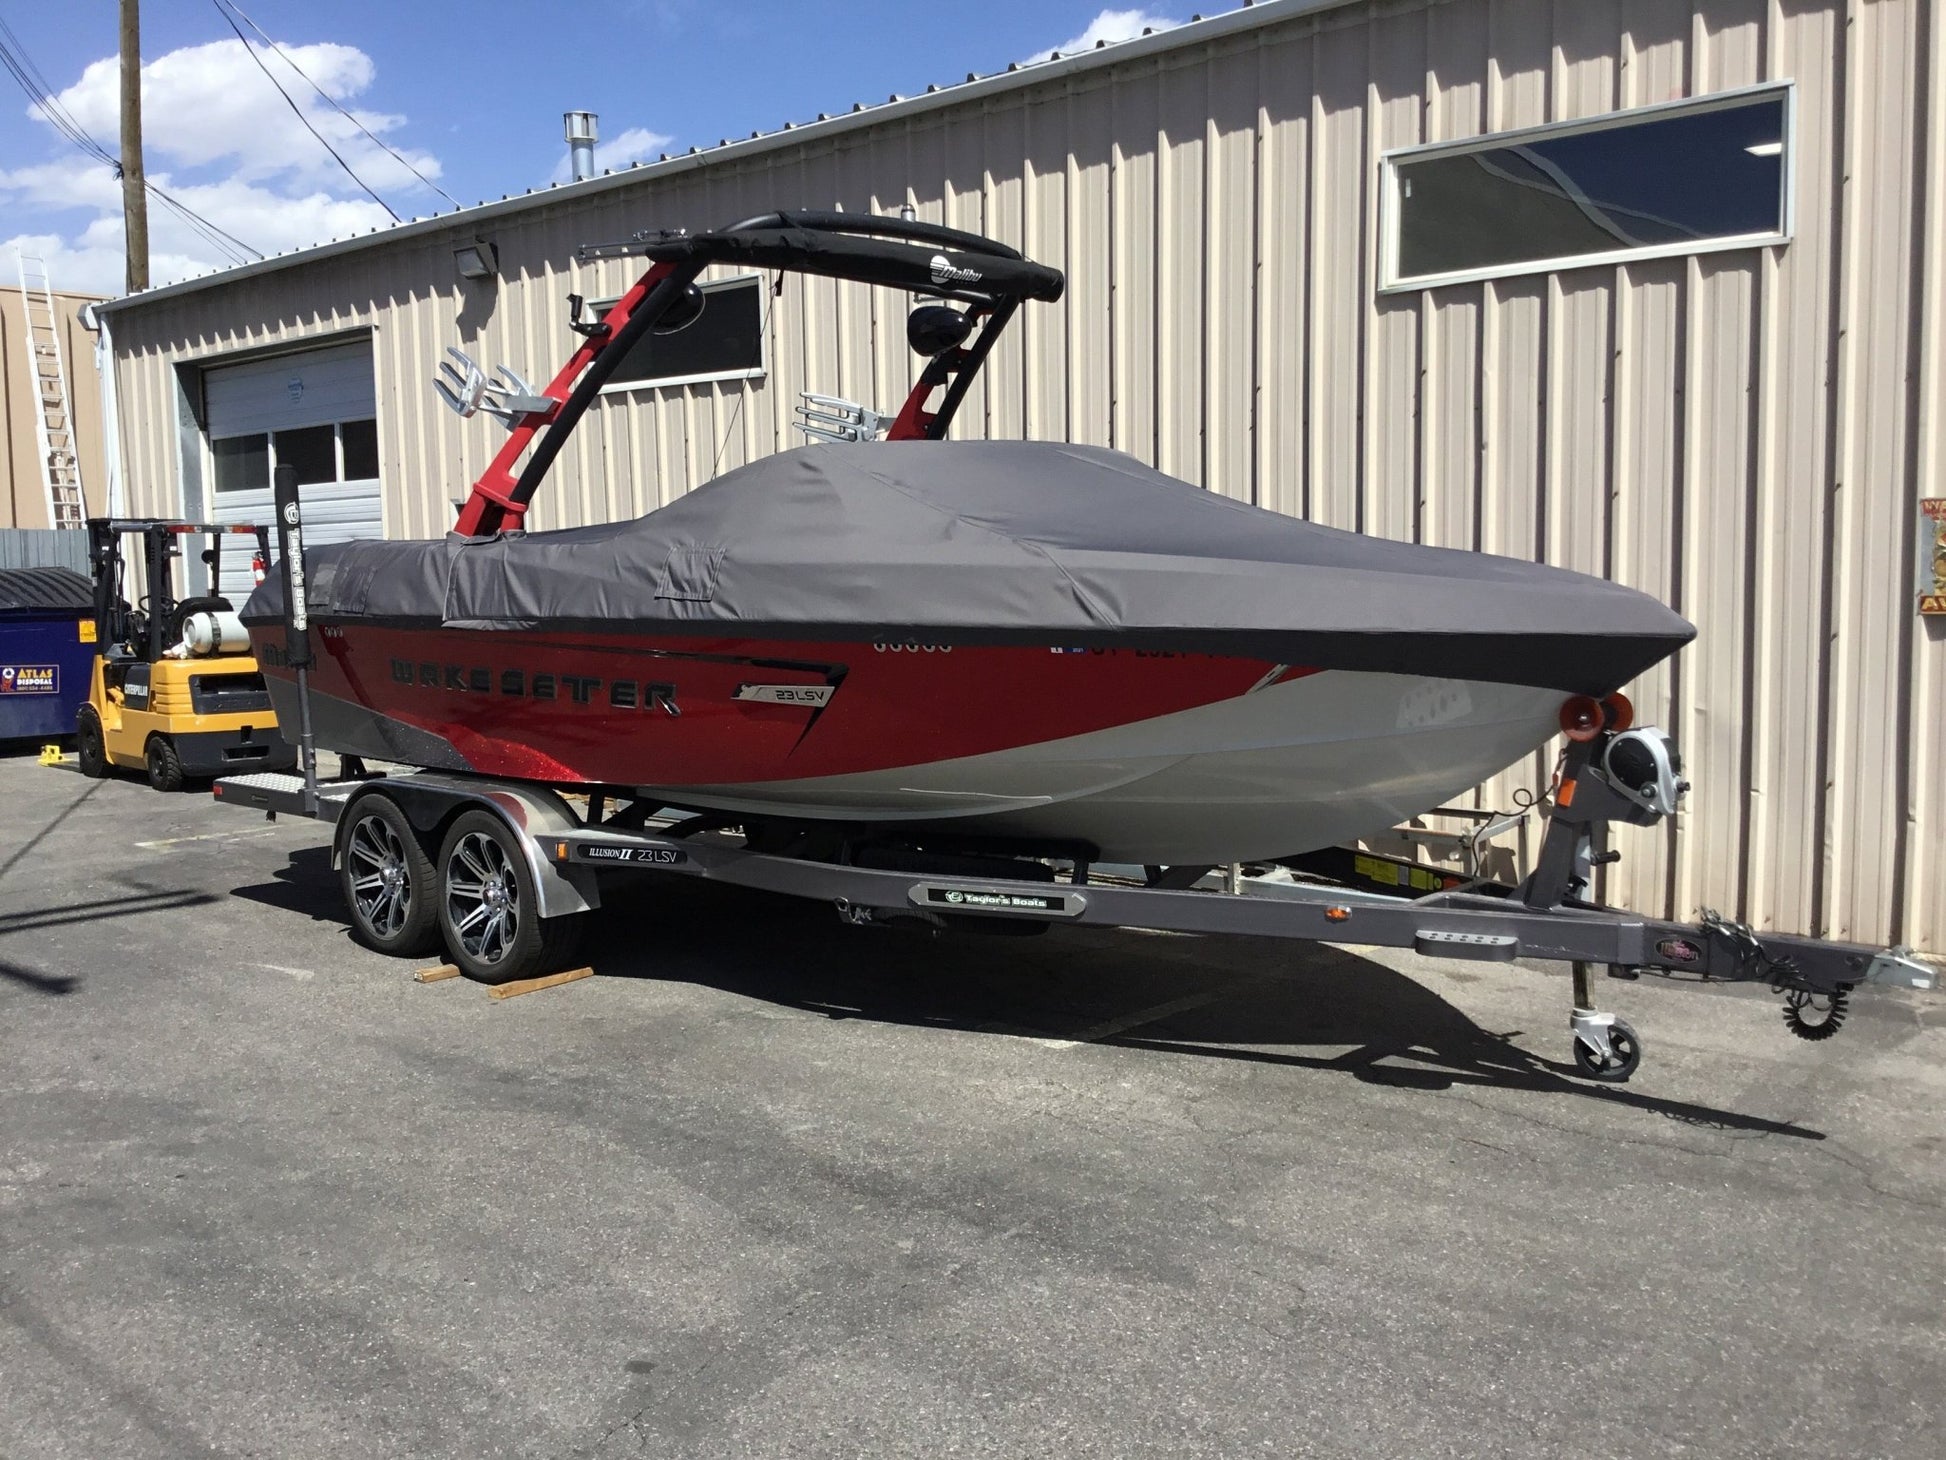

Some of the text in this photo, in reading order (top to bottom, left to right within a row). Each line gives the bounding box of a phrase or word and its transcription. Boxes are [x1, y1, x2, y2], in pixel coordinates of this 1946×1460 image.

[940, 265, 983, 282] Malibu
[17, 667, 53, 678] ATLAS
[16, 678, 53, 686] DISPOSAL
[391, 659, 680, 715] WAKESETTER
[589, 847, 621, 859] ILLUSION
[963, 893, 1047, 908] Taylor's Boats
